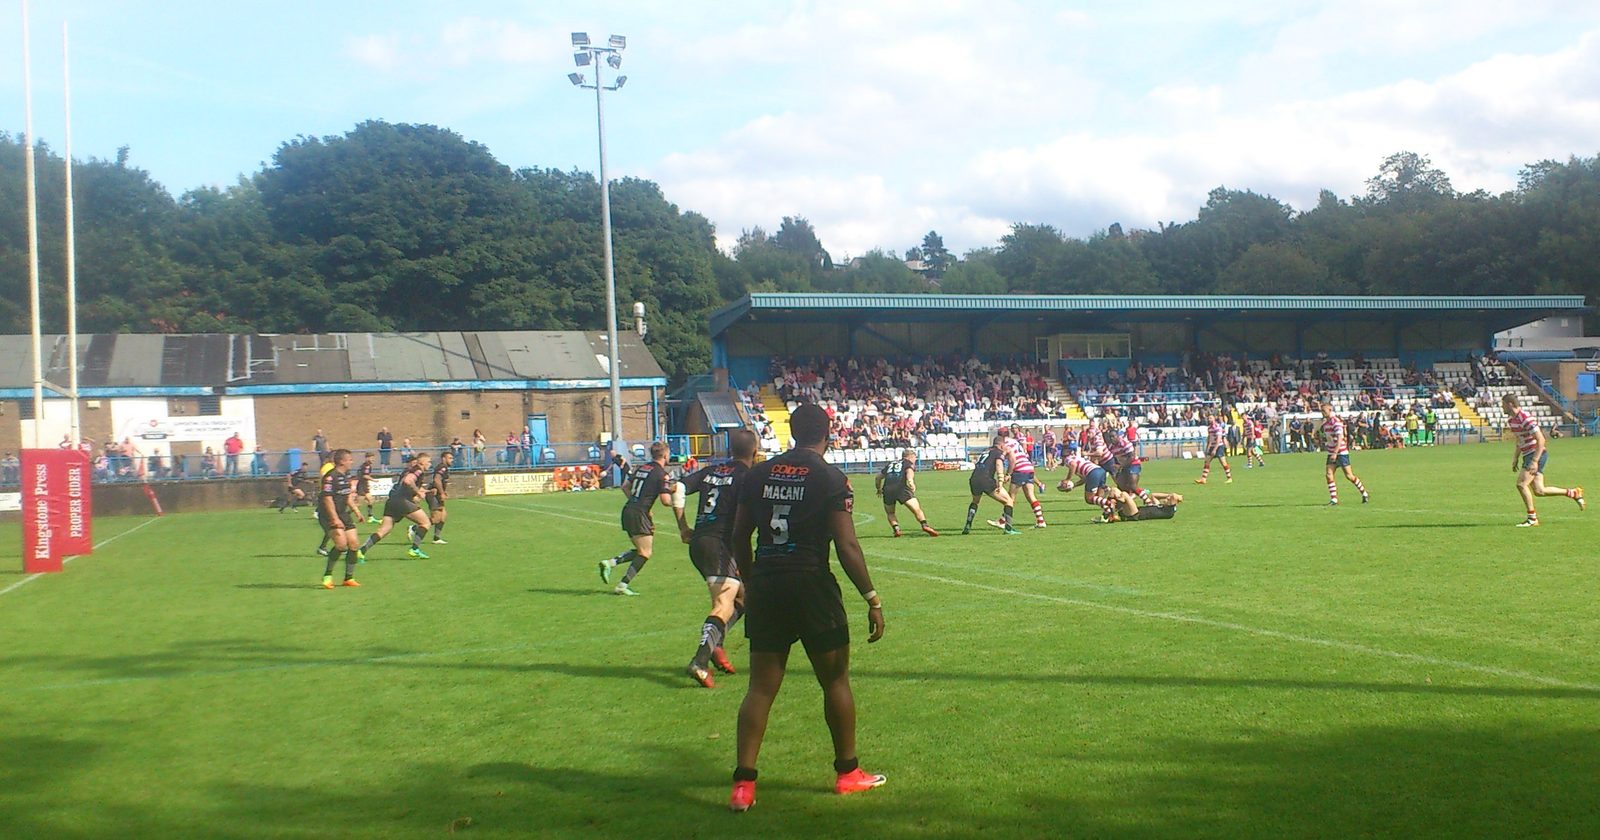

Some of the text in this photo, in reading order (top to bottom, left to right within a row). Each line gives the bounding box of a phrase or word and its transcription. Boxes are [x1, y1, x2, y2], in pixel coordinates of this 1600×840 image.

[490, 474, 554, 484] ALKIE LIMITE
[886, 462, 903, 474] 29
[69, 468, 82, 538] PROPER CIDER
[703, 487, 720, 514] 3
[762, 484, 805, 501] MACANI
[34, 464, 52, 559] Kingstone Press
[769, 504, 792, 545] 5
